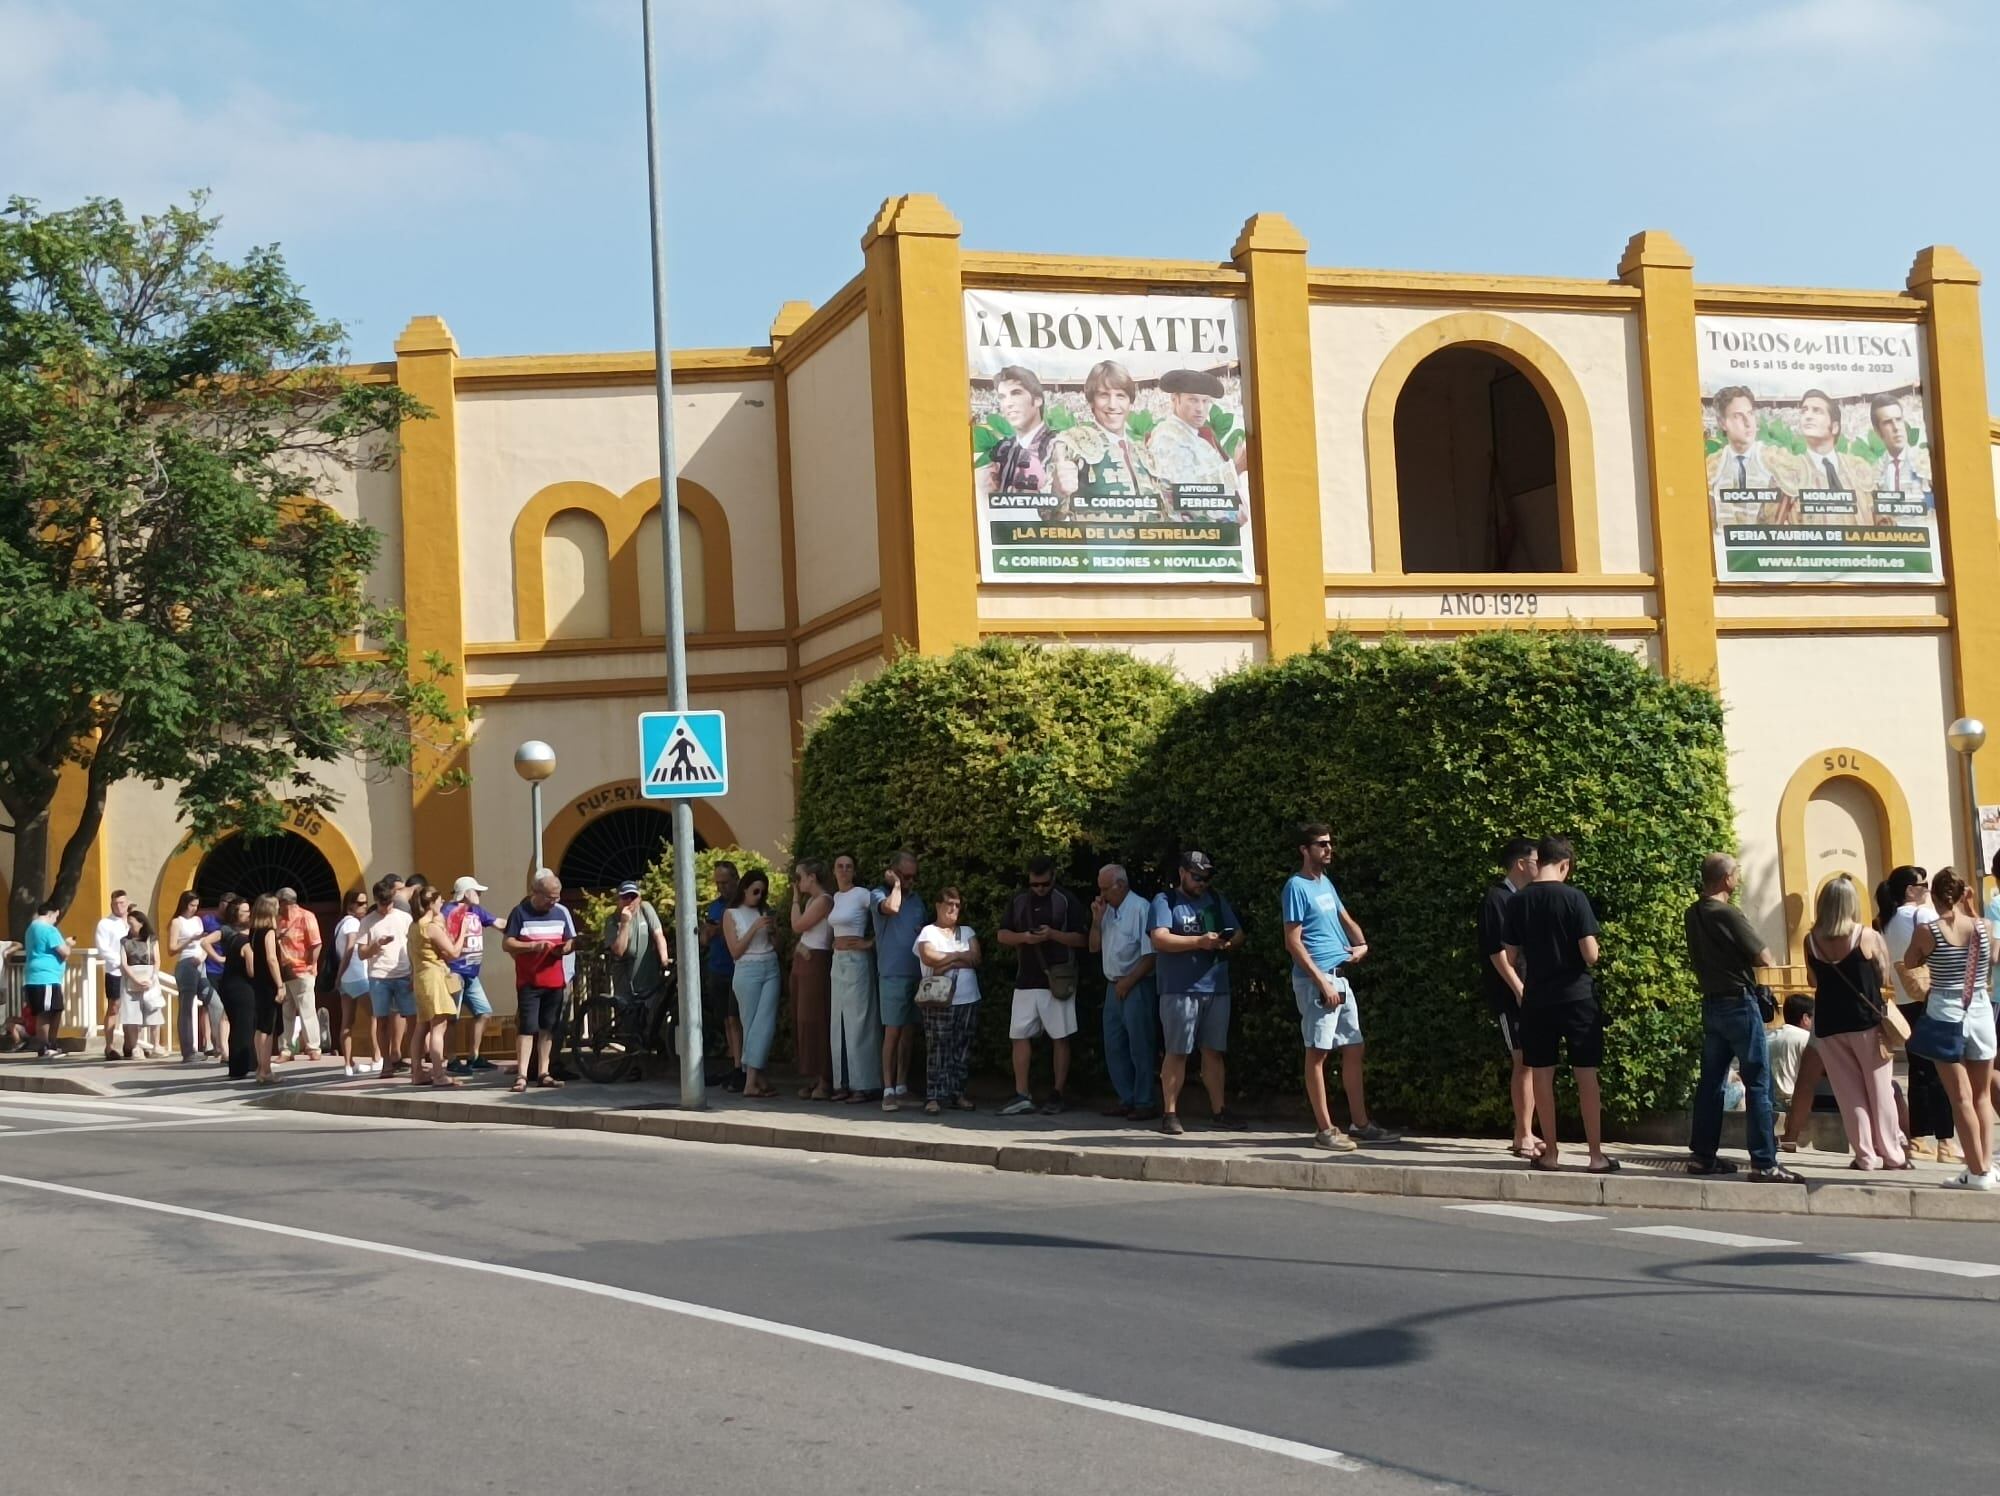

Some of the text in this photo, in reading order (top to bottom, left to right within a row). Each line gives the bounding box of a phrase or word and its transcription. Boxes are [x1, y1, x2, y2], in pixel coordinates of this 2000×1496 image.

[977, 306, 1229, 354] ¡ABÓNATE!
[1706, 330, 1790, 353] TOROS
[1825, 335, 1912, 358] HUESCA
[1730, 359, 1894, 374] Del 5 al 15 de agosto de 2023
[990, 496, 1059, 507] CAYETANO
[1074, 496, 1158, 508] EL CORDOBÉS
[1180, 498, 1234, 508] FERRERA
[1039, 527, 1082, 539] FERIA
[1085, 528, 1105, 539] DE
[1108, 528, 1135, 539] LAS
[1729, 531, 1767, 541] FERIA
[1845, 531, 1860, 541] LA
[999, 556, 1238, 568] 4 CORRIDAS REJONES NOVILLADA
[1823, 754, 1860, 771] SOL
[576, 783, 645, 817] PUERT
[293, 811, 322, 836] BIS
